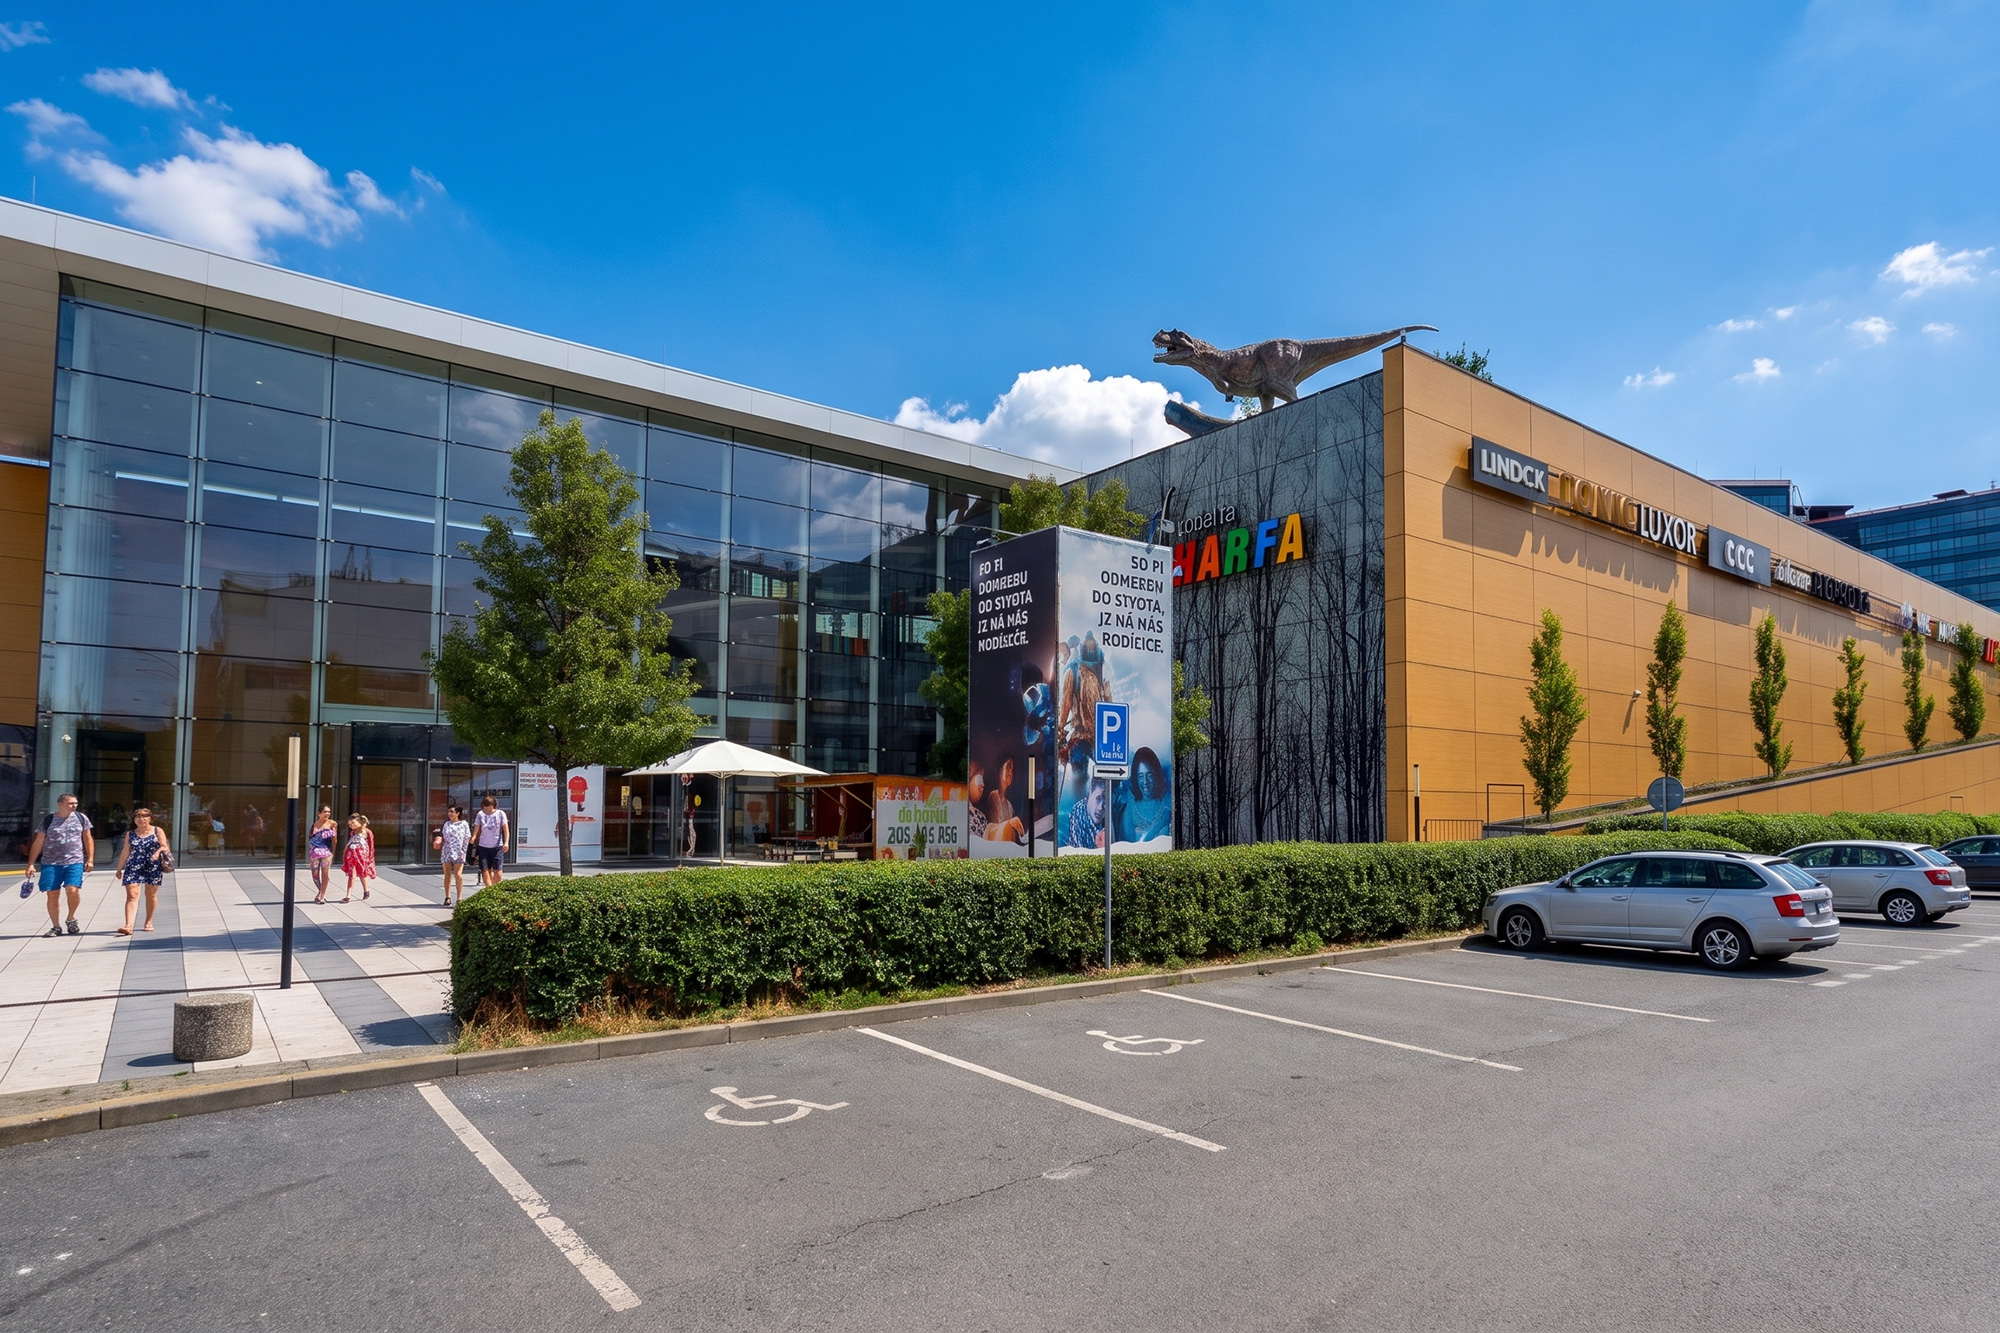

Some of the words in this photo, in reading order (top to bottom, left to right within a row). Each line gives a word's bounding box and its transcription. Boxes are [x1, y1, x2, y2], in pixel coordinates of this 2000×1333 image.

[1640, 503, 1697, 555] LUXOR
[1173, 512, 1304, 588] HARFA
[1724, 539, 1755, 574] CCC
[978, 599, 993, 614] OD
[1092, 590, 1111, 605] DO
[1115, 611, 1134, 629] NÁ
[1138, 615, 1164, 634] NÁS
[1102, 710, 1122, 744] P
